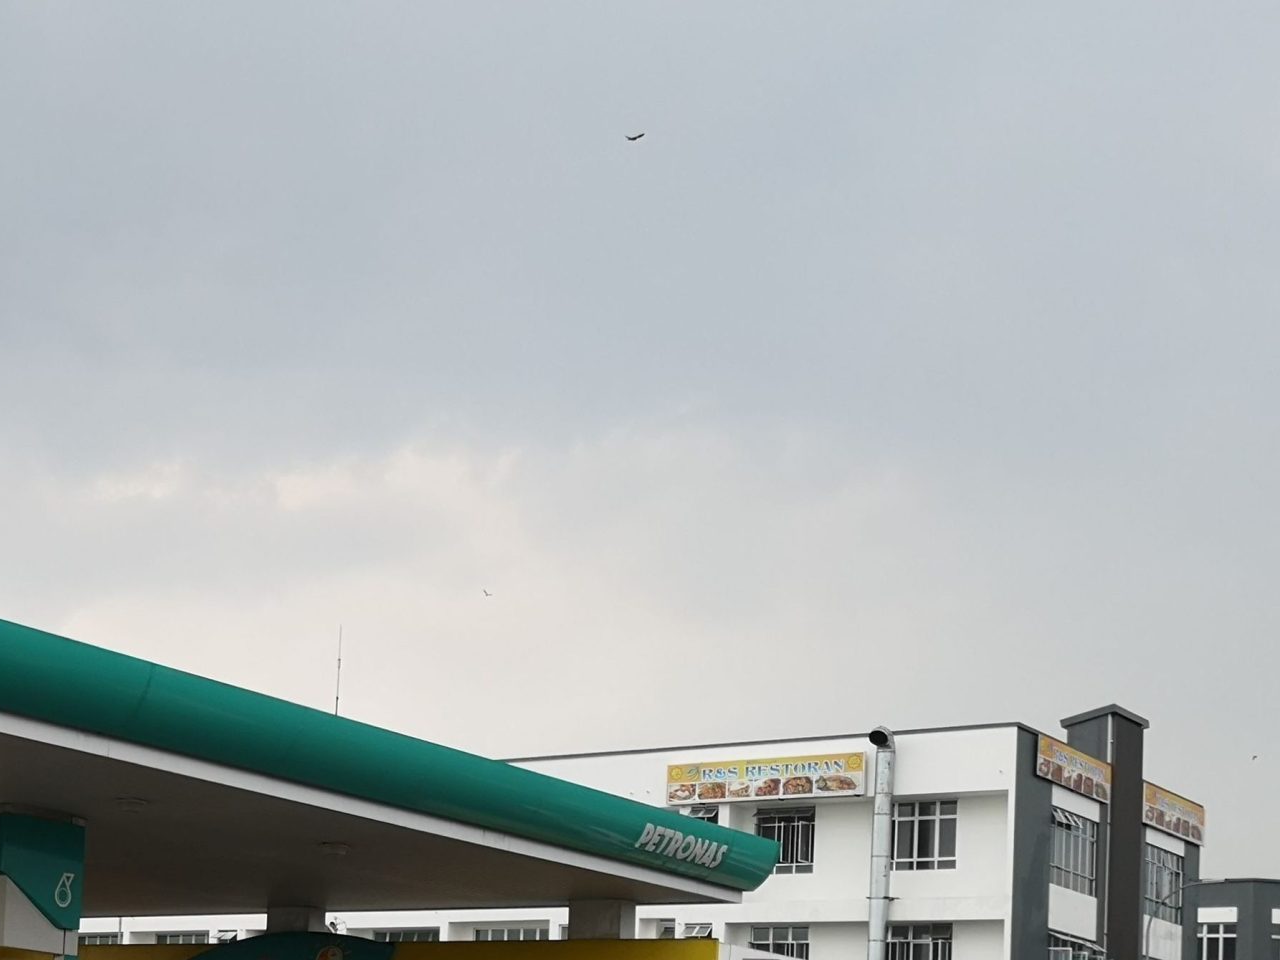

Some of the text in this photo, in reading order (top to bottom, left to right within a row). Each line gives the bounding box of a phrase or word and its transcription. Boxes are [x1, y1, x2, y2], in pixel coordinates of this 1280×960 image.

[702, 759, 845, 780] R&S RESTORAN
[634, 822, 729, 869] PETRONAS
